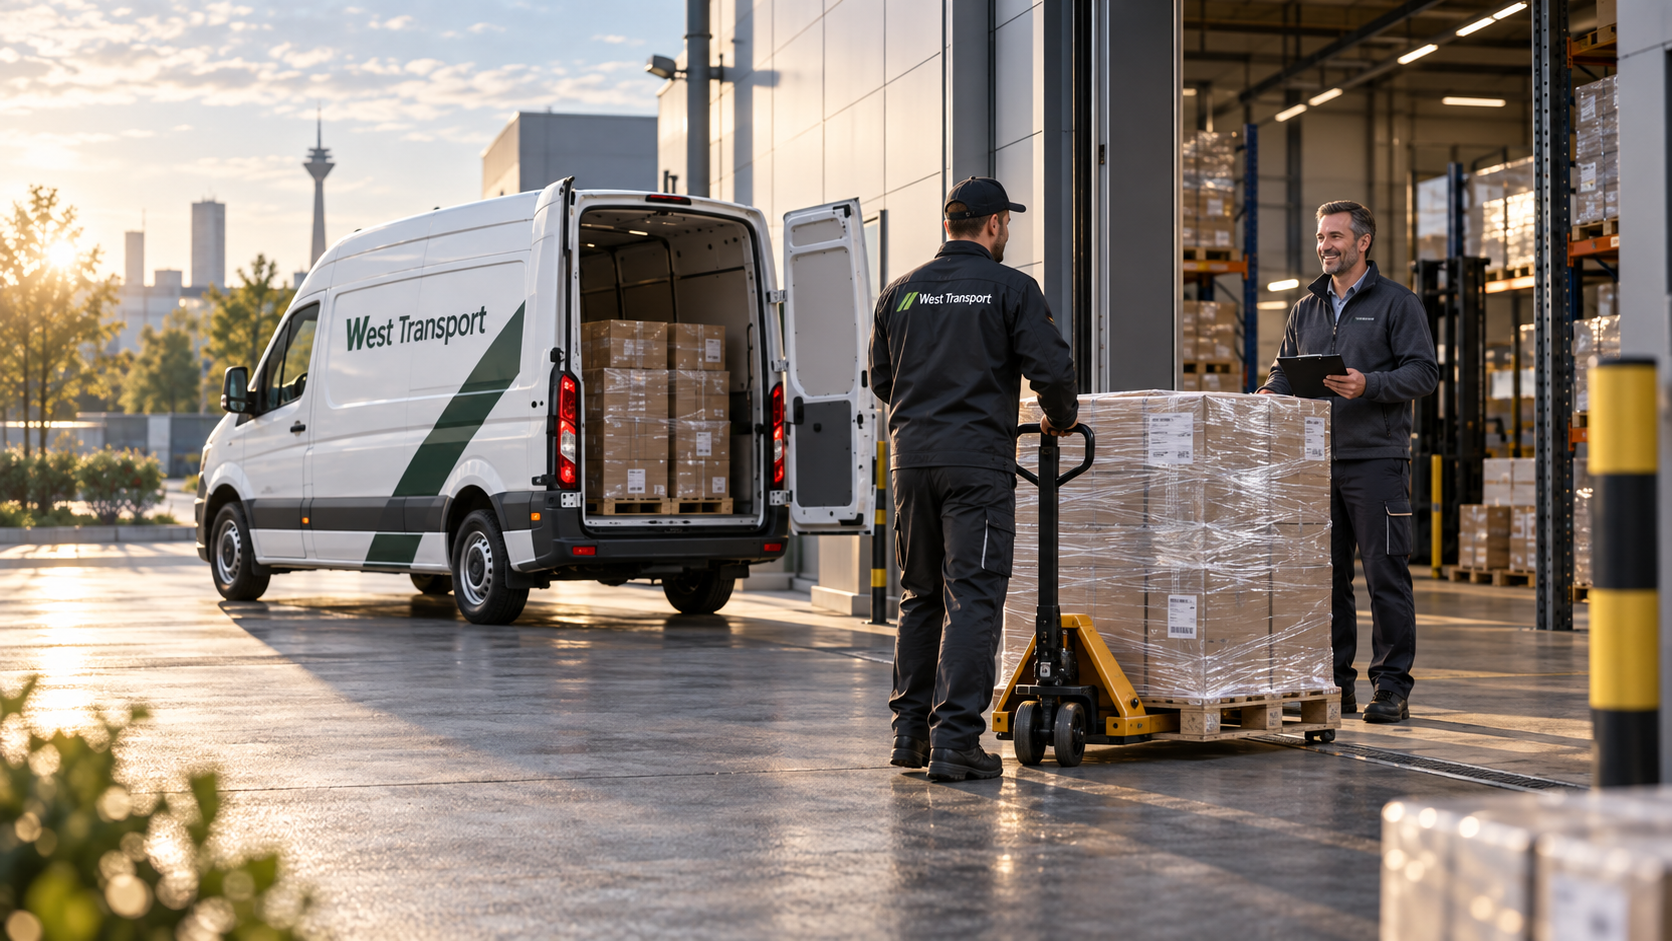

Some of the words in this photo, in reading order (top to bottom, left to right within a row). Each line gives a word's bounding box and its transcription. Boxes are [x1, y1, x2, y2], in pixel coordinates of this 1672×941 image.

[919, 293, 944, 304] West
[945, 292, 992, 305] Transport
[346, 315, 394, 352] West
[399, 306, 487, 346] Transport
